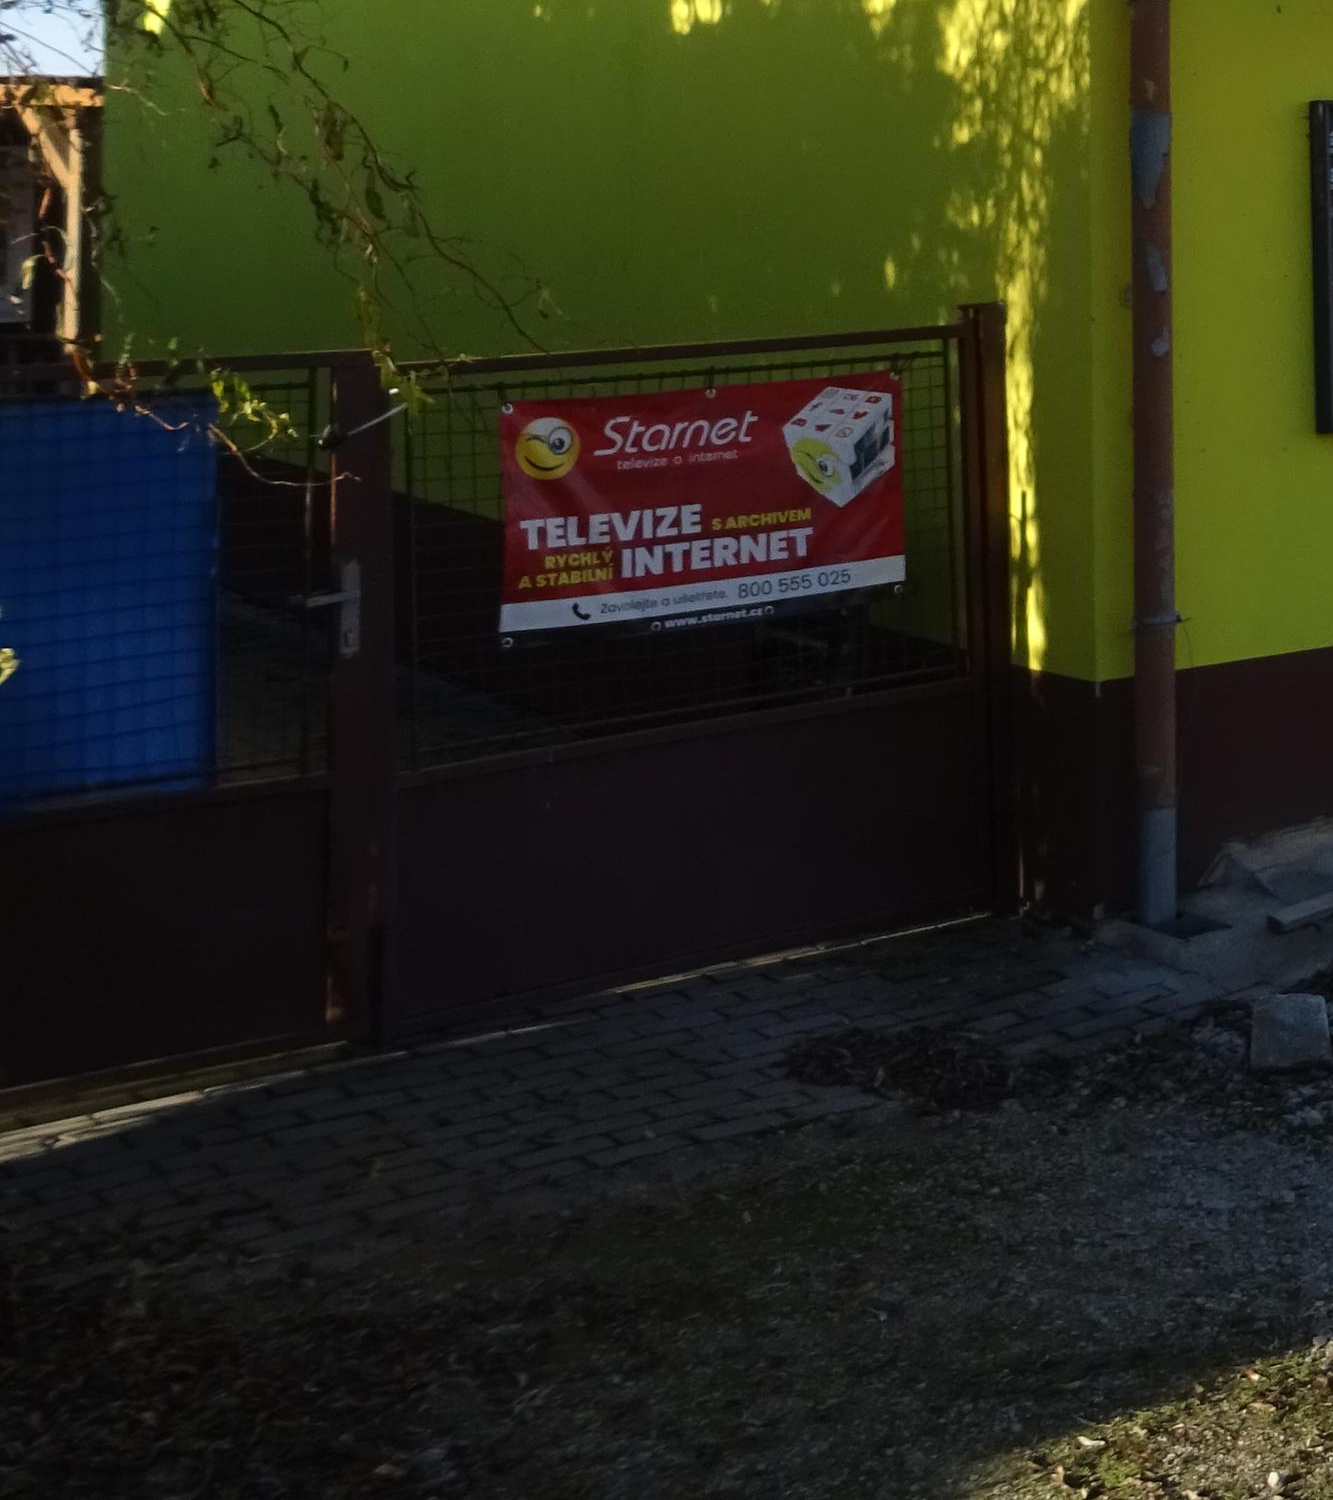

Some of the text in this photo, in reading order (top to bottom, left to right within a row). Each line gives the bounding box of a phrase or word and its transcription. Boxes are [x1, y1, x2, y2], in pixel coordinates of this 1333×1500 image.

[593, 410, 759, 456] Starnet
[617, 455, 669, 470] televize
[688, 449, 738, 464] internet
[520, 504, 812, 550] TELEVIZE S ARCHIVEM
[544, 549, 614, 570] RYCHLÝ
[621, 527, 814, 579] INTERNET
[518, 566, 613, 589] A STABILNÍ
[737, 582, 772, 600] 800
[778, 575, 813, 594] 555
[818, 569, 852, 588] 025
[664, 608, 763, 629] www.starnet.cz
